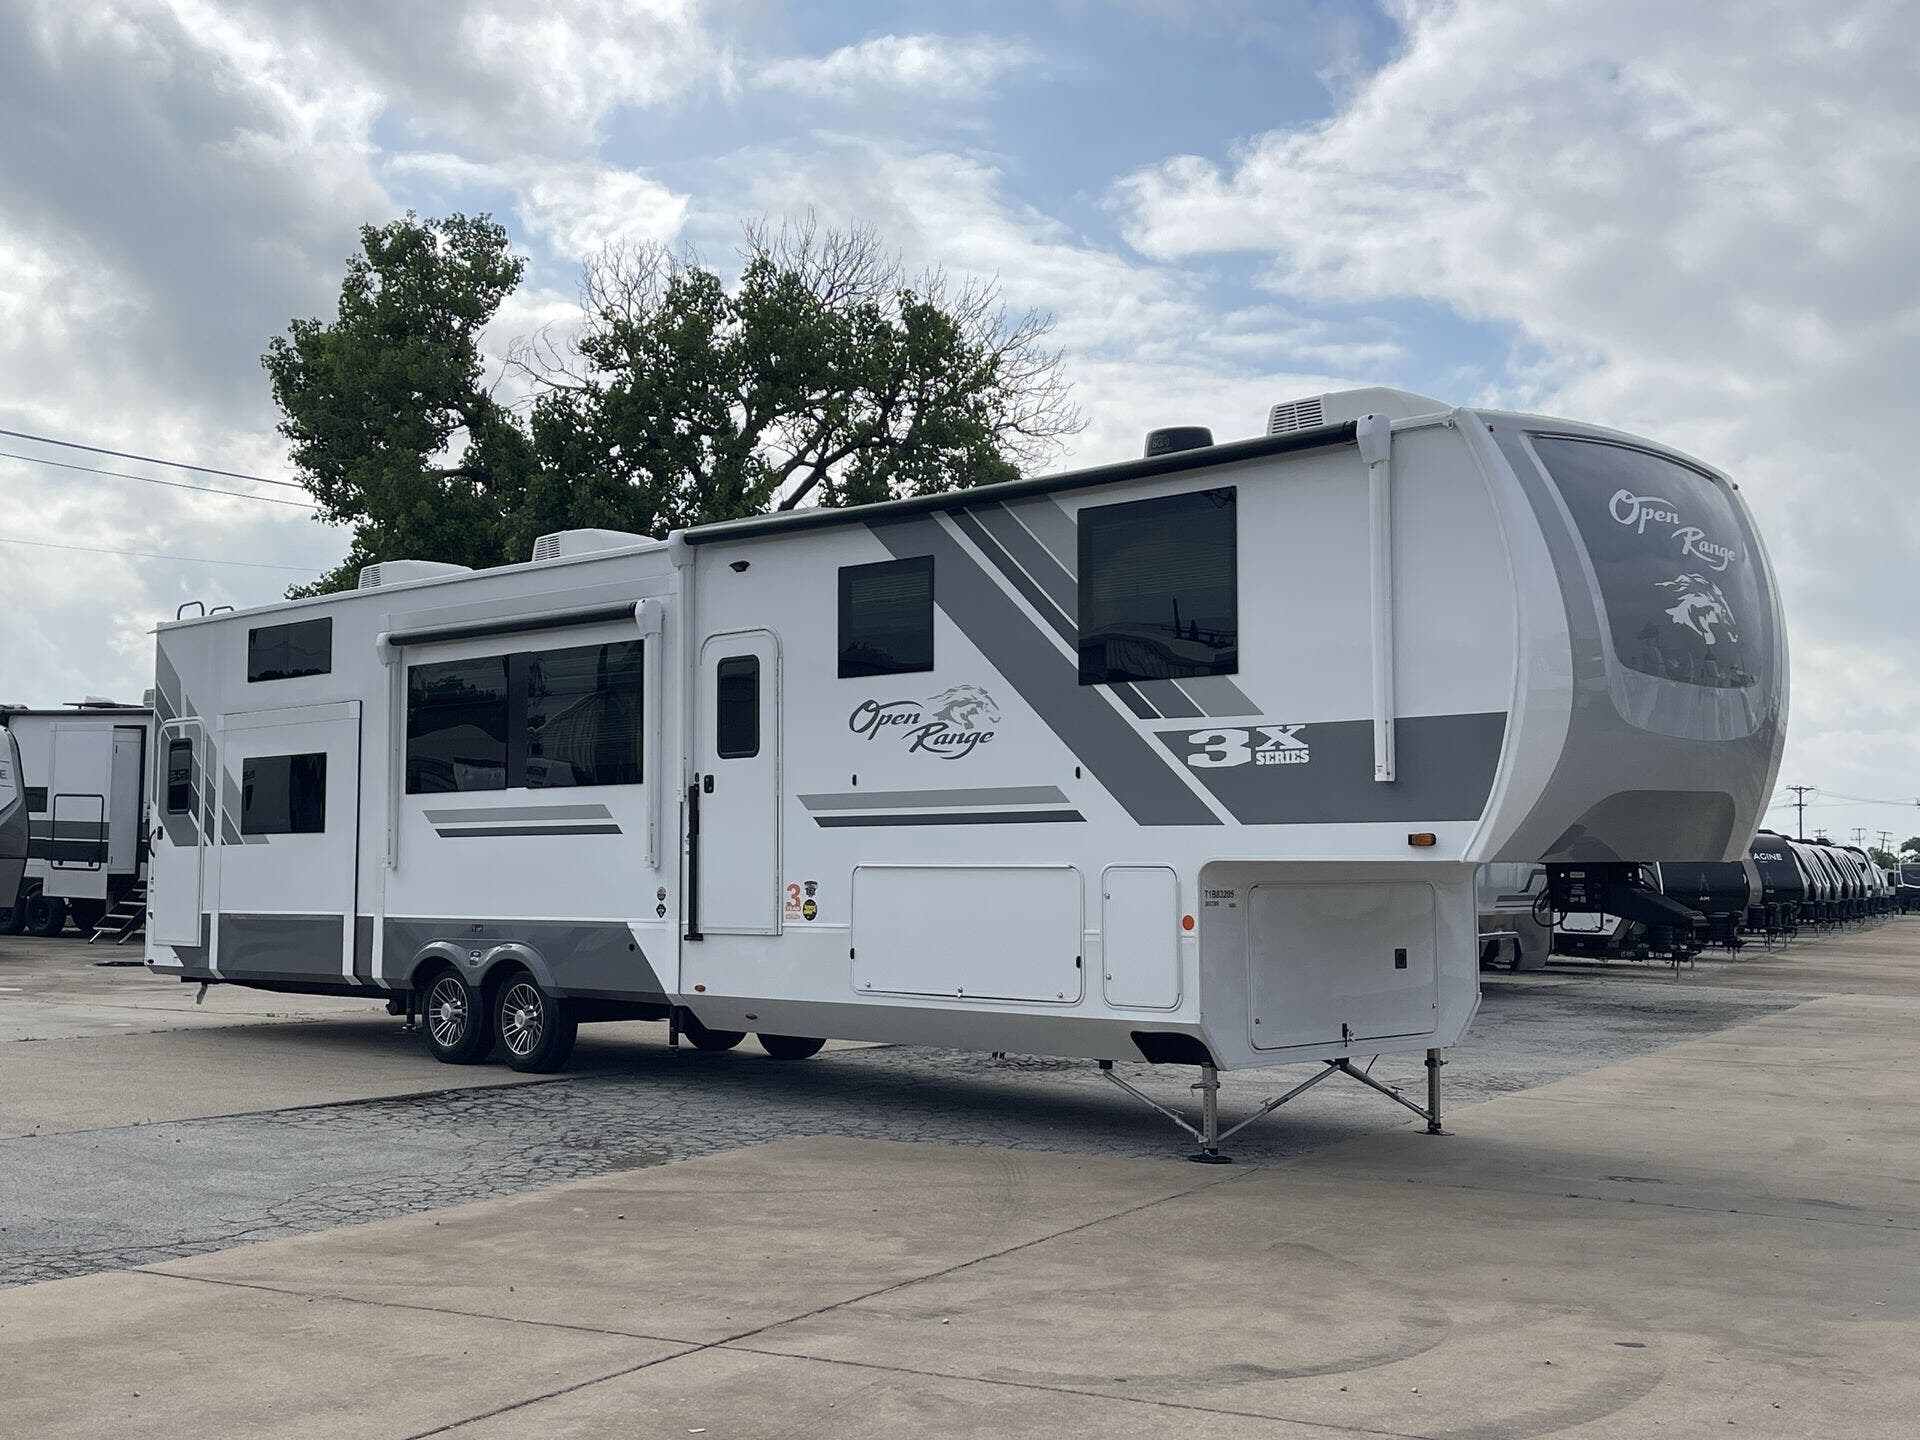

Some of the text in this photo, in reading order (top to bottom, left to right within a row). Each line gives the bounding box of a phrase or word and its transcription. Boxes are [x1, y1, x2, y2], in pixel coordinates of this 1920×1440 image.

[1608, 488, 1681, 535] Open
[1671, 526, 1737, 571] Range
[849, 699, 925, 741] Open
[901, 722, 995, 760] Range
[1255, 749, 1310, 766] SERIES
[786, 883, 801, 907] 3
